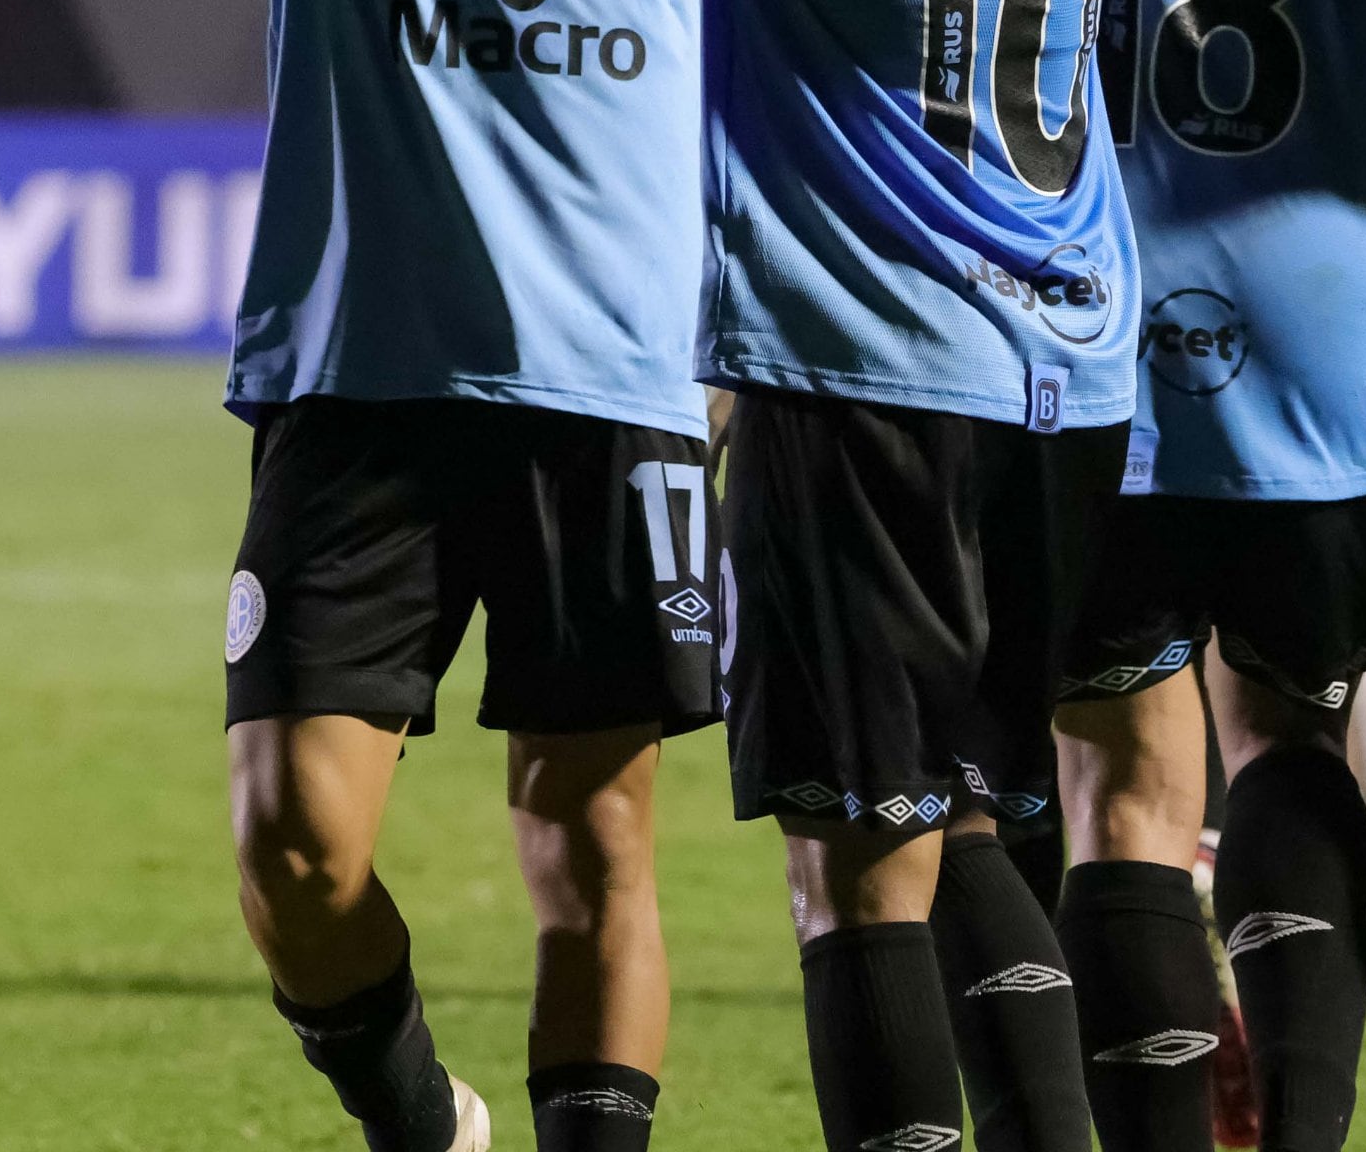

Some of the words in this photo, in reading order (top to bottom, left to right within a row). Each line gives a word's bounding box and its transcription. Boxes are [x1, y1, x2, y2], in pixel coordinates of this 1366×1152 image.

[942, 11, 964, 65] RUS
[1040, 390, 1056, 421] B
[627, 461, 706, 583] 17
[671, 624, 713, 645] umbro
